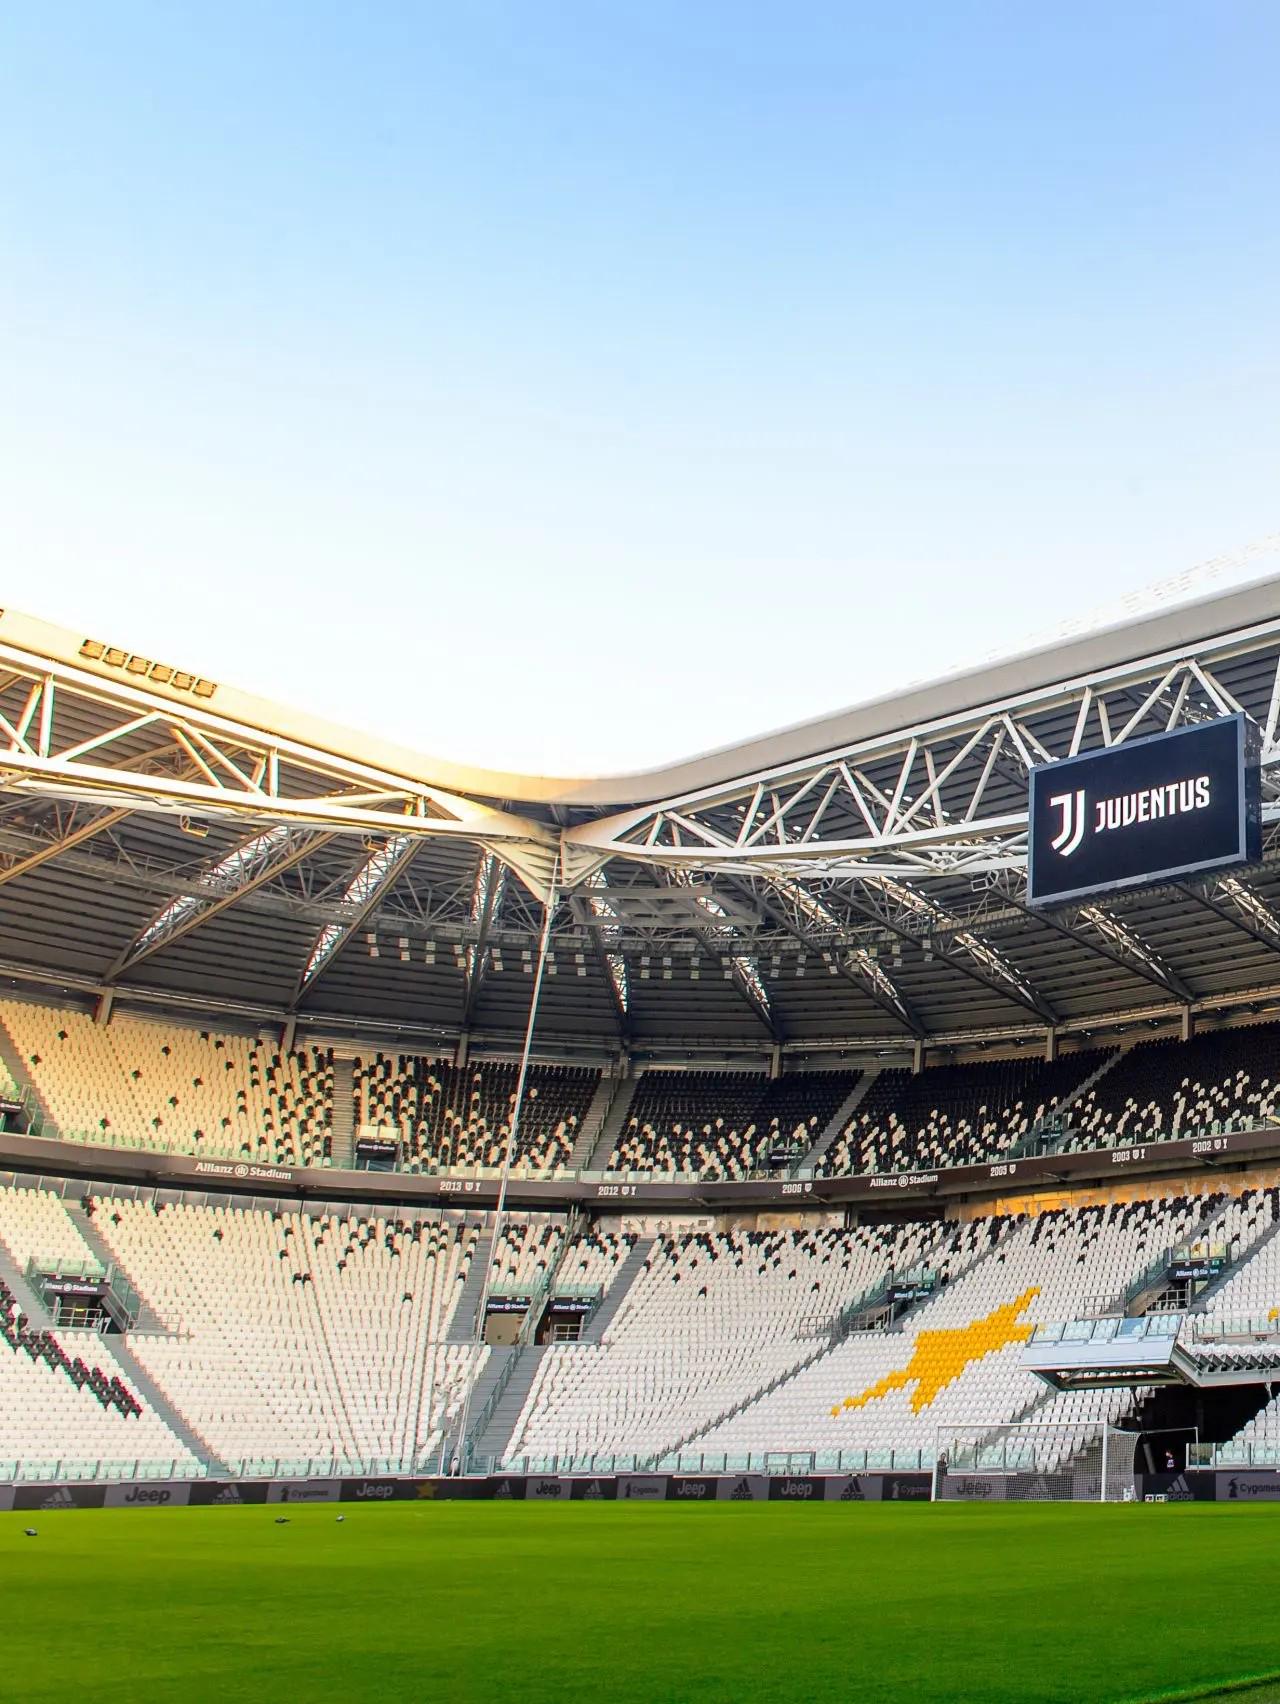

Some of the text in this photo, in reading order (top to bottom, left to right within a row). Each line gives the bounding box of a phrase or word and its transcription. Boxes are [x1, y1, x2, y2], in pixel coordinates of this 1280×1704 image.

[1095, 775, 1210, 833] JUVENTUS
[1192, 1142, 1212, 1153] 2002
[1112, 1152, 1130, 1163] 2003
[195, 1161, 292, 1180] Allianz Stadium
[440, 1180, 462, 1192] 2013
[869, 1174, 938, 1188] Allianz Stadium
[598, 1185, 619, 1196] 2012
[125, 1486, 172, 1504] Jeep
[356, 1482, 394, 1498] Jeep
[535, 1481, 561, 1497] Jeep
[677, 1480, 705, 1497] Jeep
[780, 1480, 813, 1497] Jeep
